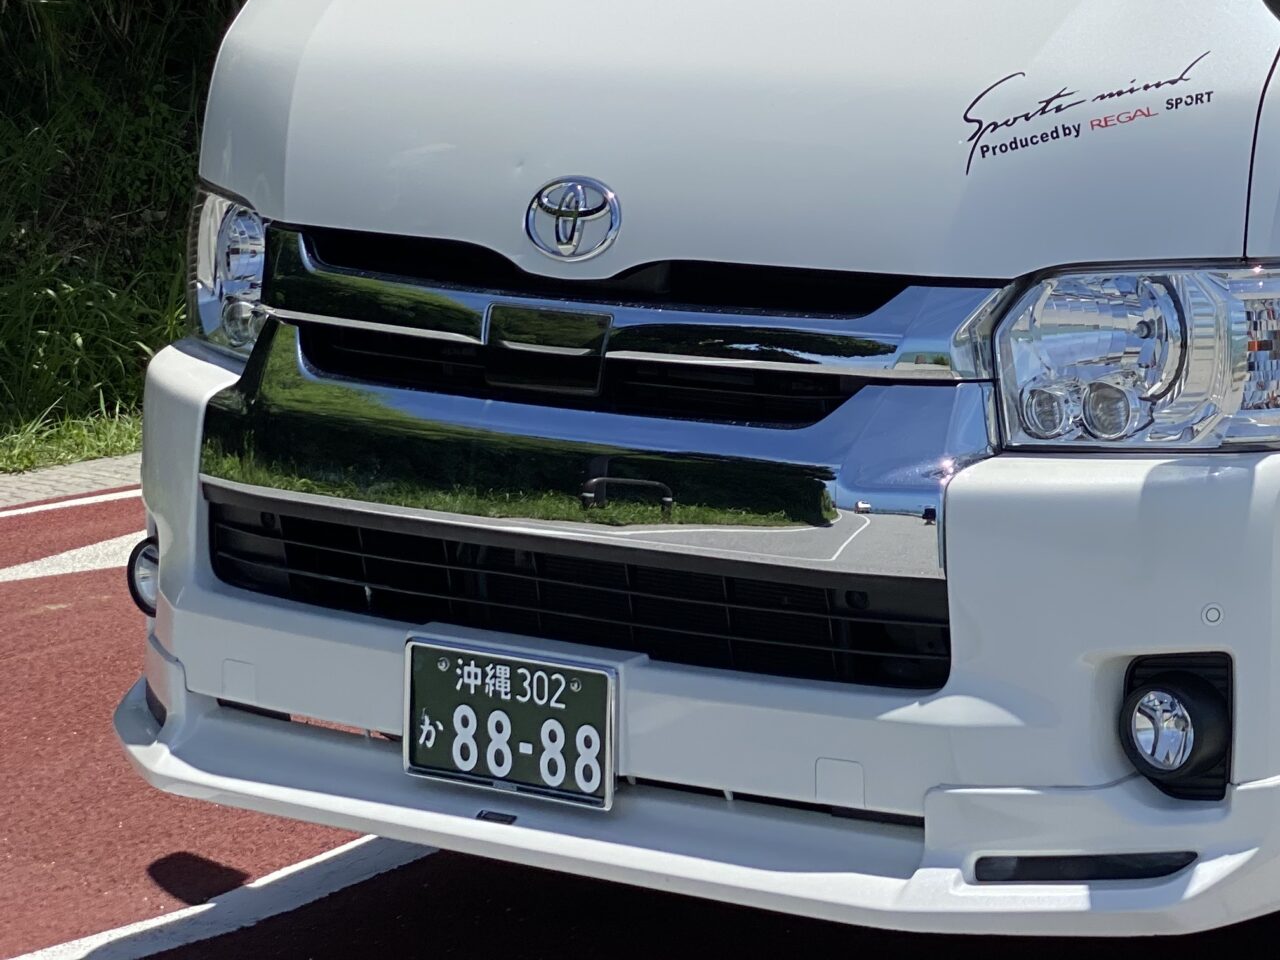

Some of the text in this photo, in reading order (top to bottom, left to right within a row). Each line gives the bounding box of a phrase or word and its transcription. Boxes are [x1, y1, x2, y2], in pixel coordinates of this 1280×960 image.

[963, 72, 1087, 175] Sports
[980, 91, 1214, 159] Produced by REGAL SPORT
[419, 704, 601, 793] か 88-88
